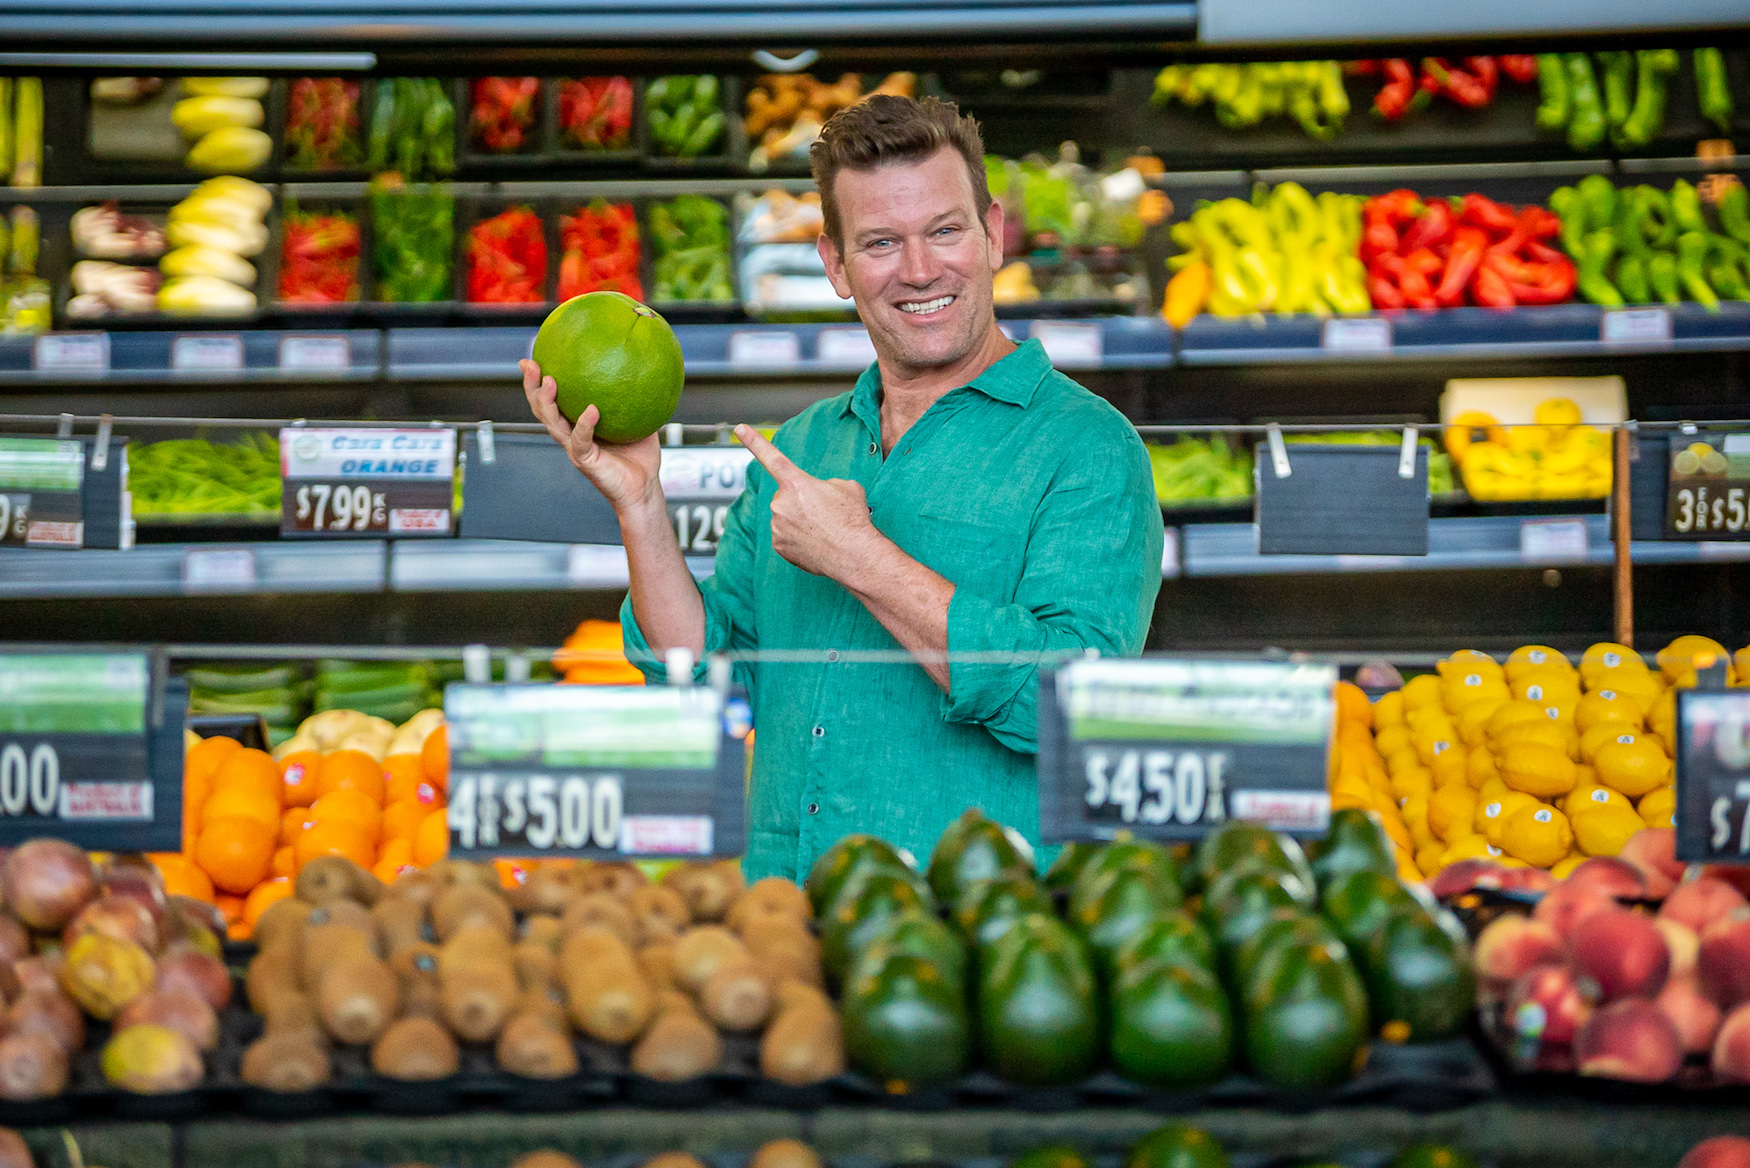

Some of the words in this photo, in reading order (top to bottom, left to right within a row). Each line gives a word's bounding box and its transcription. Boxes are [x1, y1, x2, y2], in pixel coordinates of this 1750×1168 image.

[332, 435, 383, 450] Cara
[391, 435, 443, 450] Cara
[340, 458, 440, 474] ORANGE
[1675, 489, 1694, 533] 3
[1712, 489, 1750, 533] $5.
[0, 743, 60, 816] 00
[448, 775, 476, 850] 4
